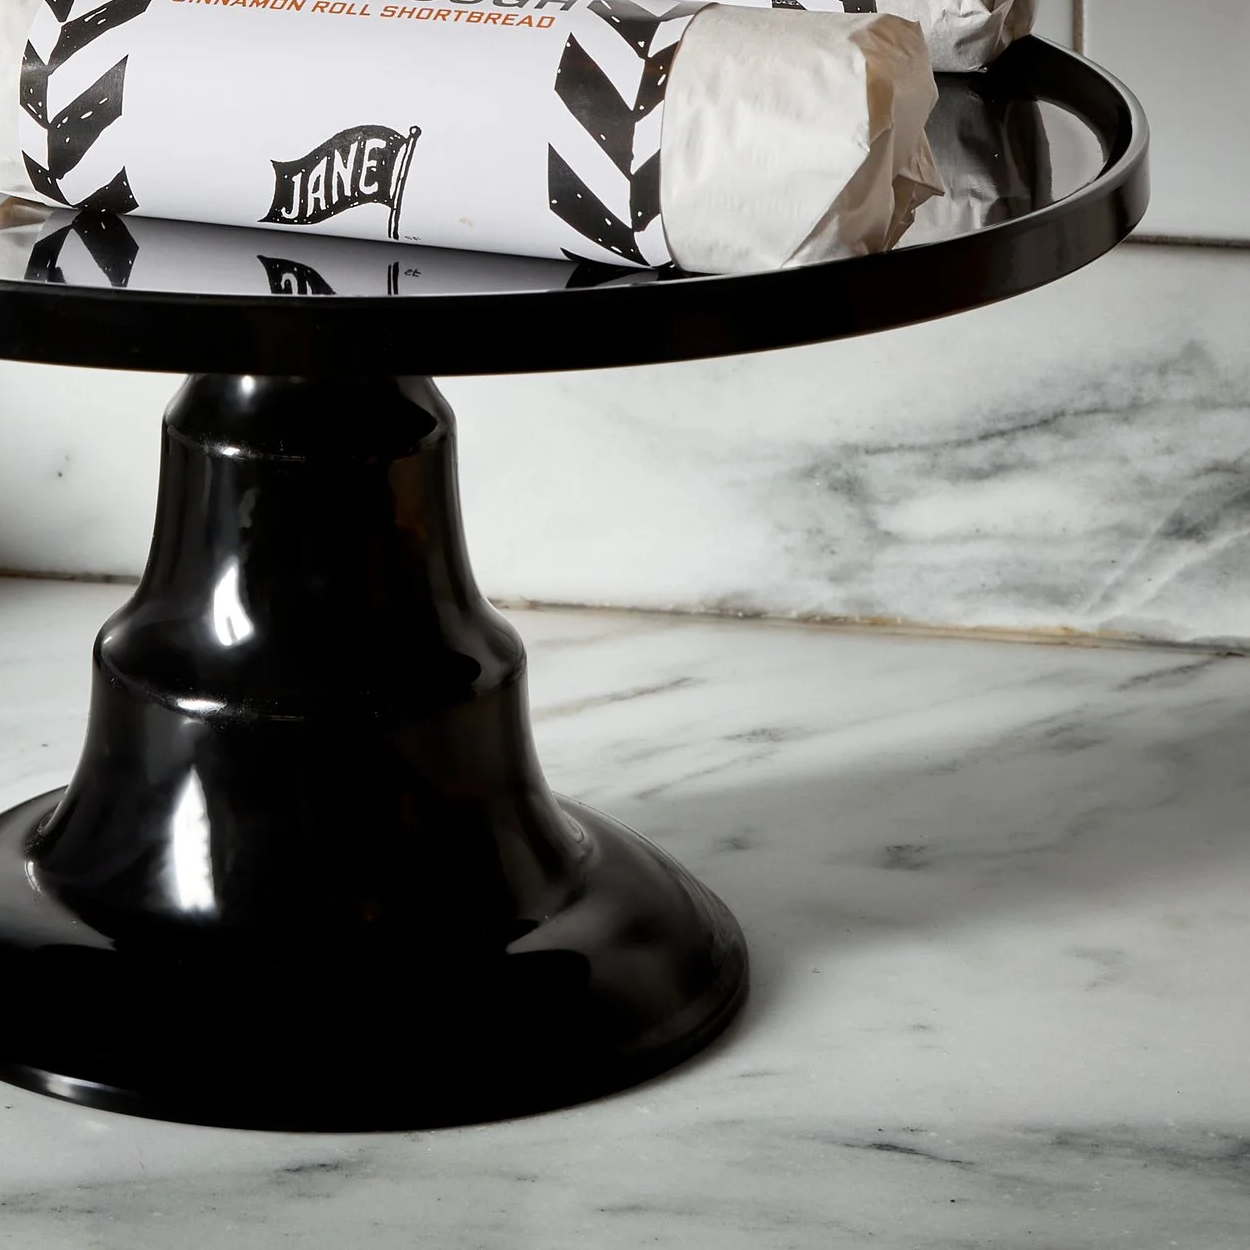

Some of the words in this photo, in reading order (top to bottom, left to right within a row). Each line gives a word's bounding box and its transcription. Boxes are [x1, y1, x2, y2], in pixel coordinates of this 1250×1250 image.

[311, 1, 371, 17] ROLL
[379, 5, 556, 29] SHORTBREAD
[281, 138, 387, 220] JANE
